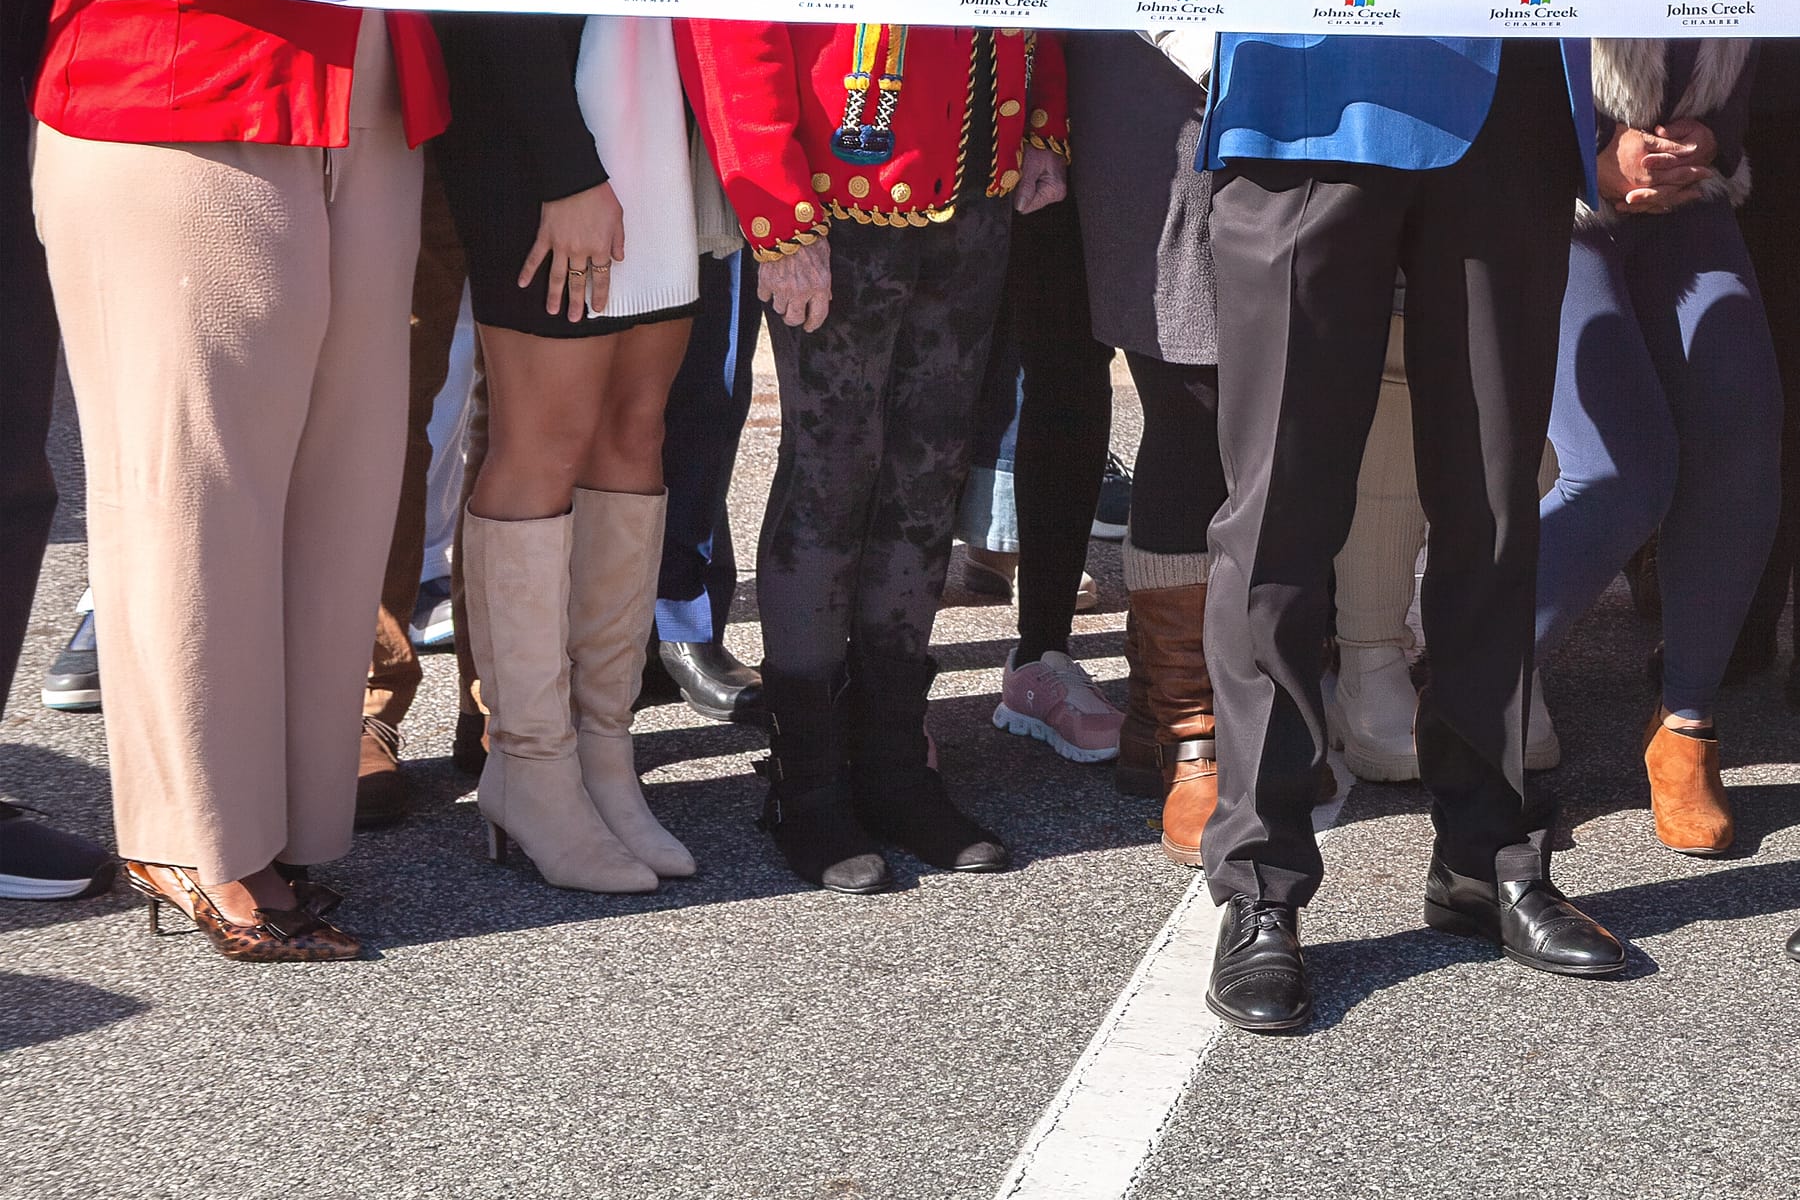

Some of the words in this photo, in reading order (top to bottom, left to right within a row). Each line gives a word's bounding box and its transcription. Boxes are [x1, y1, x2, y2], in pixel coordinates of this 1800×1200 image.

[1136, 1, 1177, 12] Johns
[1180, 3, 1224, 14] Creek
[1313, 7, 1354, 18] Johns
[1357, 8, 1401, 18] Creek
[1489, 7, 1531, 20] Johns
[1534, 6, 1578, 18] Creek
[1666, 2, 1708, 18] Johns
[1711, 0, 1756, 15] Creek
